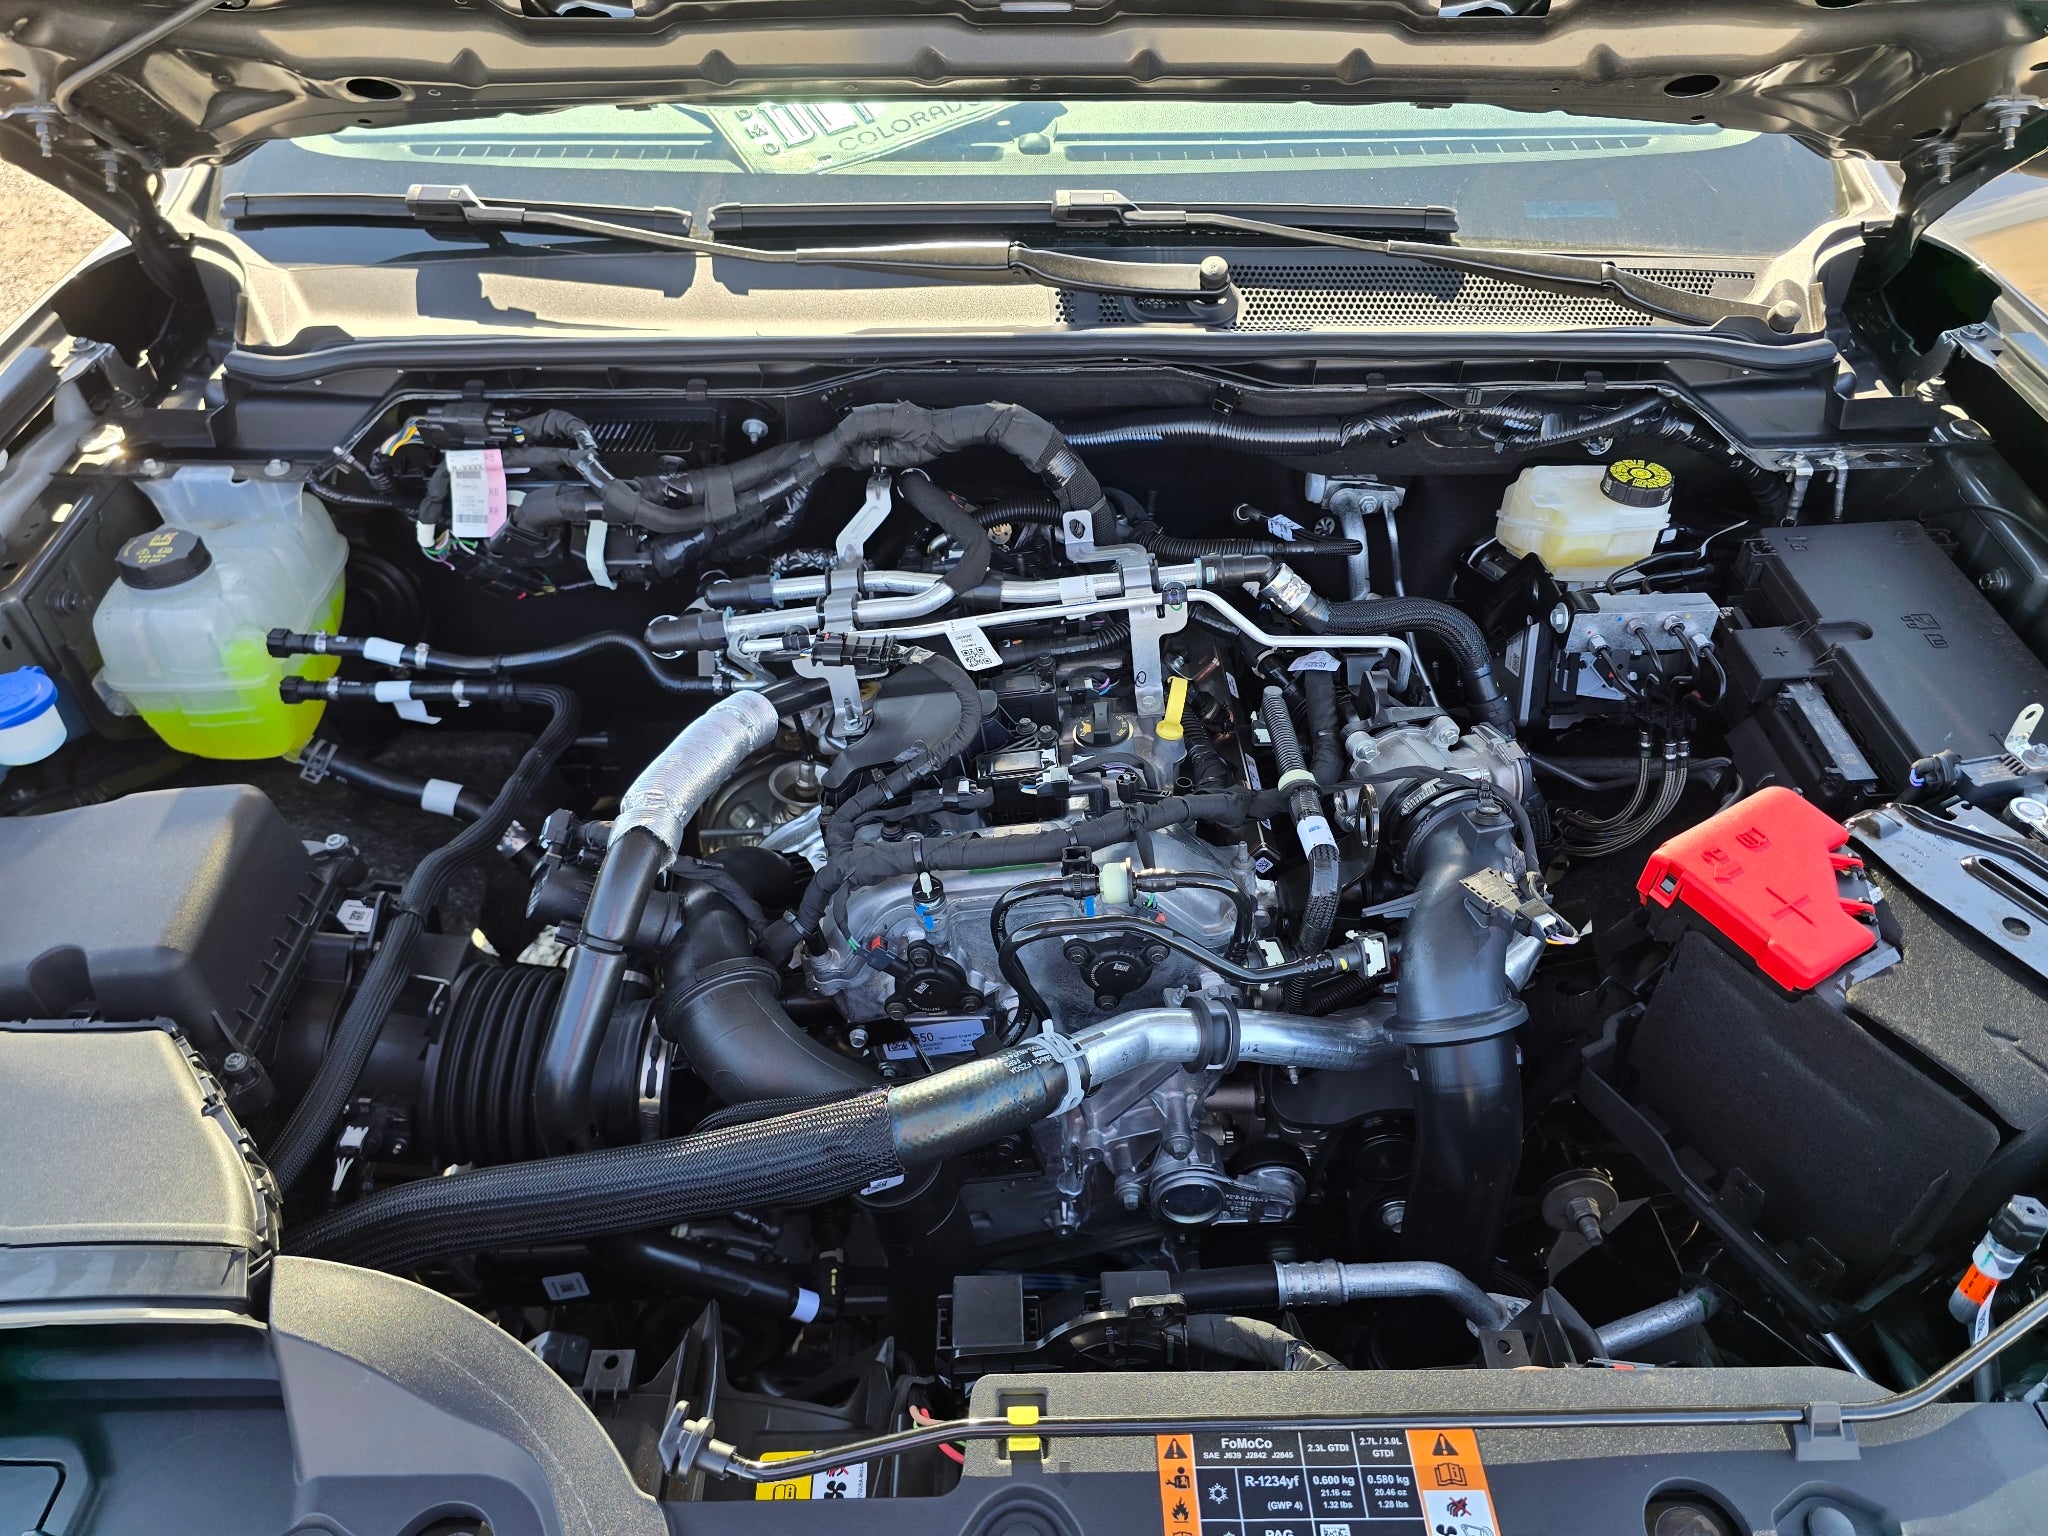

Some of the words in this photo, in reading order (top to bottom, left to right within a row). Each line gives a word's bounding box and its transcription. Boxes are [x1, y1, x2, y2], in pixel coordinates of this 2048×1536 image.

[838, 102, 981, 151] COLORAD
[1221, 1437, 1273, 1449] FoMoCo
[1359, 1437, 1377, 1446] 2.7L
[1383, 1437, 1402, 1446] 3.0L
[1307, 1443, 1326, 1452] 2.3L
[1327, 1443, 1349, 1452] GTDI
[1372, 1449, 1394, 1457] GTDI
[1244, 1475, 1300, 1490] R-1234yf
[1312, 1475, 1340, 1485] 0.600
[1342, 1475, 1355, 1486] kg
[1367, 1474, 1394, 1484] 0.580
[1396, 1474, 1410, 1486] kg
[1374, 1488, 1395, 1496] 20.46
[1267, 1501, 1293, 1512] (GWP
[1293, 1501, 1303, 1512] 4)
[1323, 1501, 1339, 1509] 1.32
[1340, 1500, 1353, 1509] lbs
[1378, 1501, 1394, 1509] 1.28
[1395, 1500, 1409, 1509] lbs
